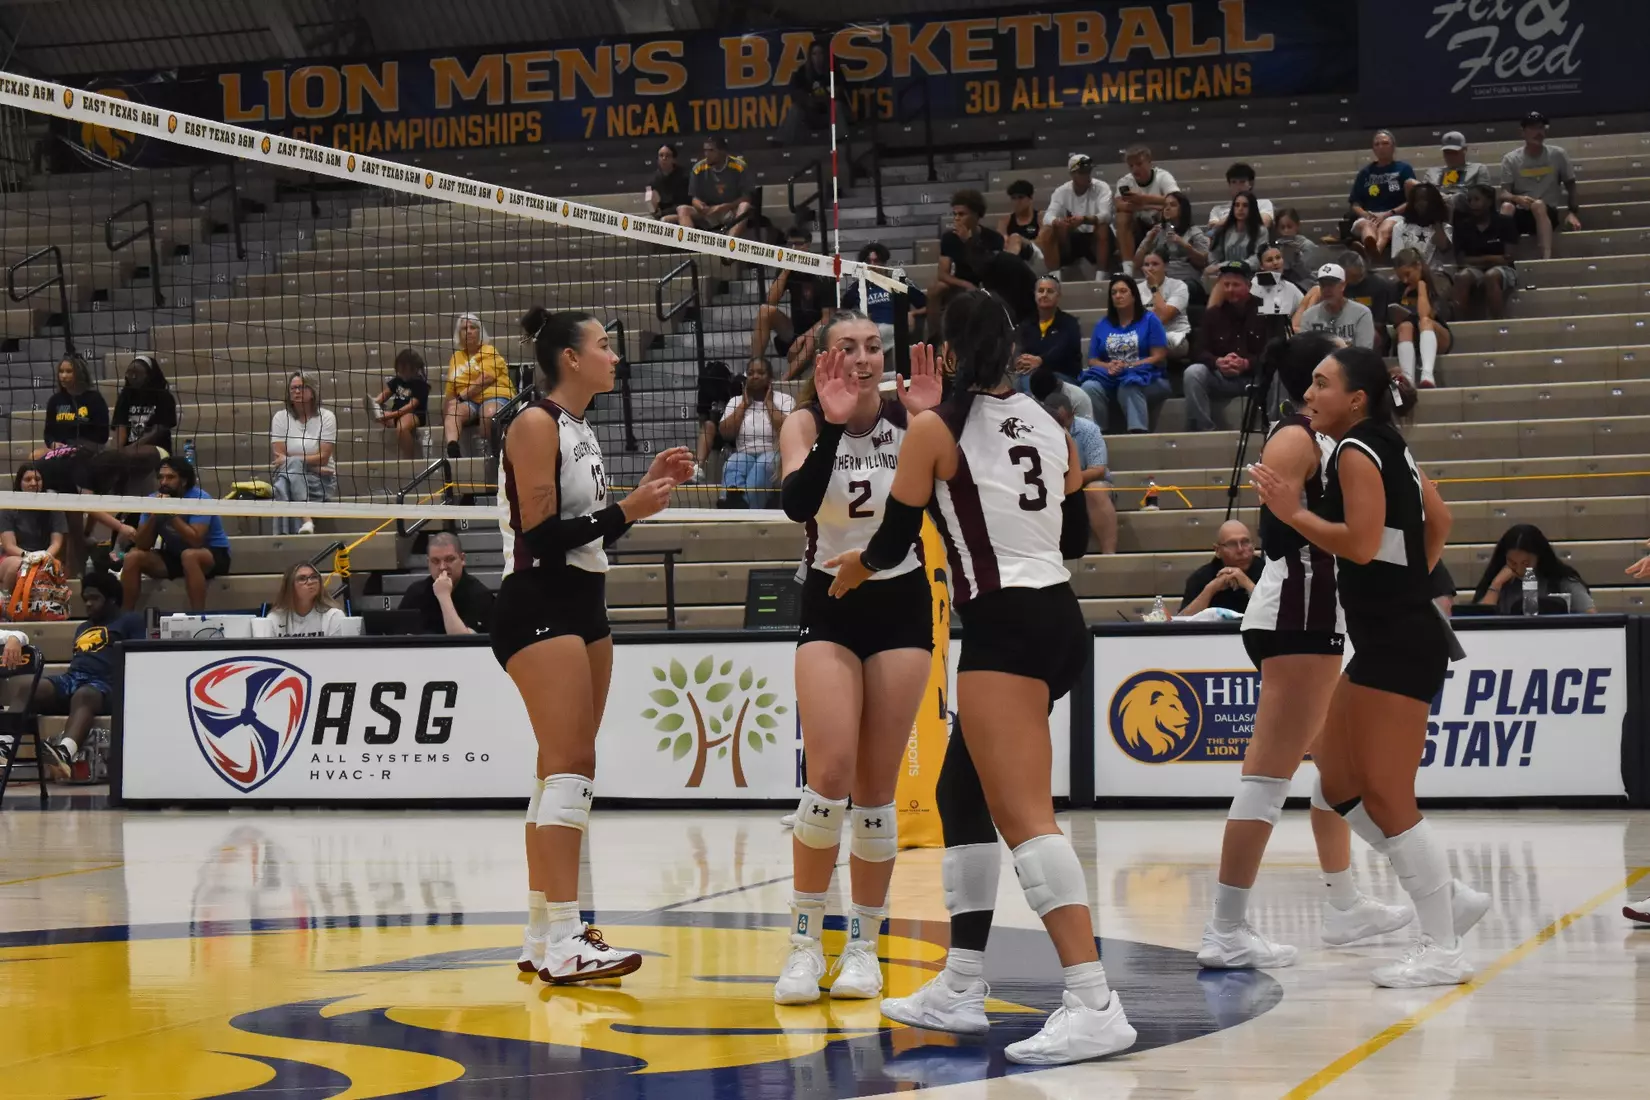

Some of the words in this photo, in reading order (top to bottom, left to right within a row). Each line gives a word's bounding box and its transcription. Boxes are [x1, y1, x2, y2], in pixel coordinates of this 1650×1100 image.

[218, 61, 399, 122] LION
[430, 41, 687, 109] MEN'S
[720, 0, 1274, 89] BASKETBALL
[1447, 23, 1584, 93] Feed
[0, 78, 29, 97] TEXAS
[82, 96, 106, 114] EAST
[109, 103, 138, 122] TEXAS
[141, 111, 159, 127] A&M
[333, 111, 542, 153] CHAMPIONSHIPS
[581, 107, 597, 139] 7
[607, 102, 679, 138] NCAA
[689, 86, 893, 132] TOURNANTS
[965, 80, 1000, 114] 30
[1012, 62, 1251, 112] ALL-AMERICANS
[185, 122, 207, 139] EAST
[209, 128, 235, 145] TEXAS
[238, 134, 255, 149] A&M
[277, 142, 297, 157] EAST
[299, 147, 323, 163] TEXAS
[361, 160, 380, 176] EAST
[382, 165, 403, 181] TEXAS
[438, 178, 456, 192] EAST
[457, 182, 477, 197] TEXAS
[509, 193, 524, 206] EAST
[526, 196, 544, 210] TEXAS
[573, 207, 588, 220] EAST
[588, 211, 606, 224] TEXAS
[868, 292, 890, 300] ATAR
[834, 454, 861, 470] THERN
[865, 453, 898, 469] ILLINOI
[1008, 445, 1047, 511] 3
[849, 480, 875, 518] 2
[1430, 670, 1454, 715] T
[1464, 668, 1612, 715] PLACE
[311, 681, 458, 745] ASG
[1232, 724, 1255, 733] LAKE
[1206, 746, 1239, 755] LION
[1228, 737, 1249, 745] OFFI
[1419, 720, 1537, 767] STAY!
[310, 770, 391, 780] HVAC-R
